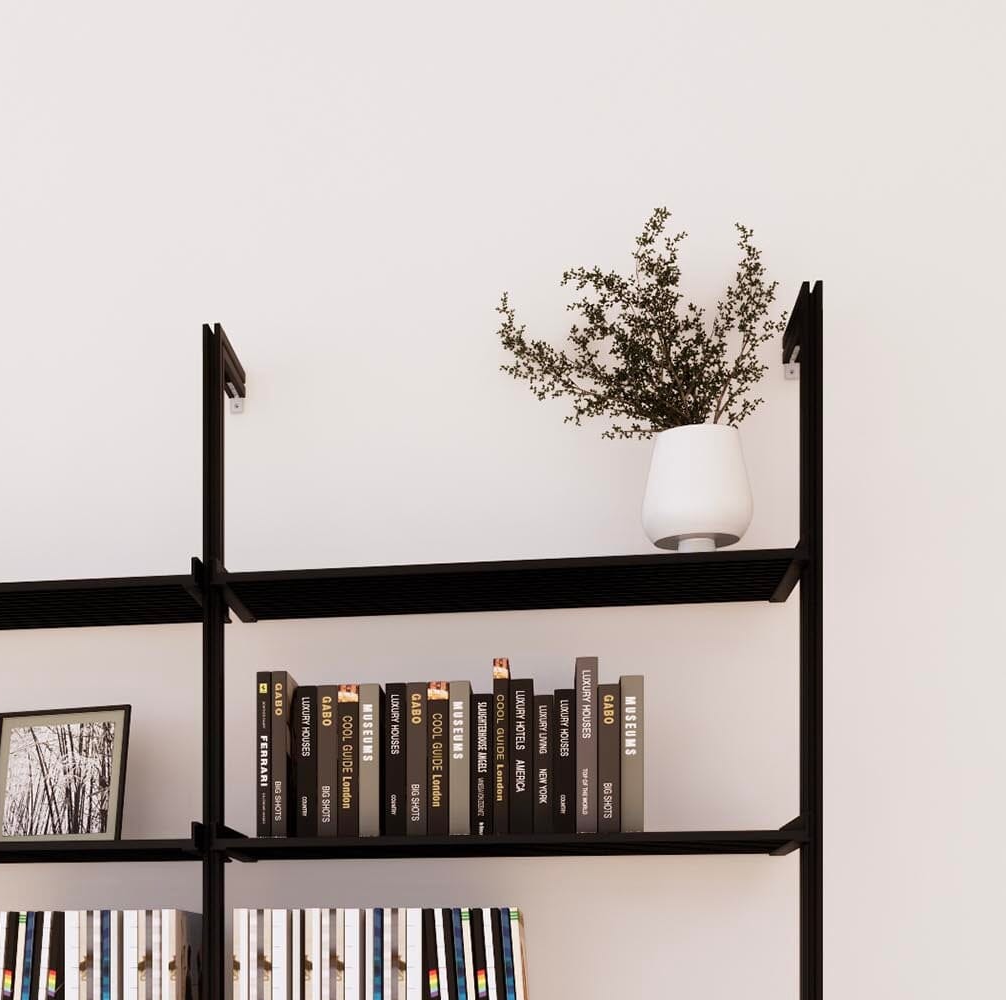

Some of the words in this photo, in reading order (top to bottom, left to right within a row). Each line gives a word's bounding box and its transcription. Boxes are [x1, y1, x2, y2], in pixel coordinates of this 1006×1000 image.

[275, 682, 283, 716] GABO
[582, 670, 591, 703] LUXURY
[301, 696, 310, 726] LUXURY
[322, 696, 332, 727] GABO
[390, 694, 399, 722] LUXURY
[411, 693, 422, 725] GABO
[496, 694, 505, 724] COOL
[515, 690, 525, 720] LUXURY
[539, 705, 547, 732] LUXURY
[560, 699, 569, 727] LUXURY
[603, 694, 614, 725] GABO
[342, 715, 353, 742] COOL
[362, 703, 373, 762] MUSEUMS
[432, 713, 443, 739] COOL
[452, 701, 464, 760] MUSEUMS
[477, 702, 487, 751] SLAUGHTERHOUSE
[515, 721, 525, 750] HOTELS
[582, 704, 591, 739] HOUSES
[625, 696, 636, 756] MUSEUMS
[302, 726, 311, 757] HOUSES
[391, 724, 399, 755] HOUSES
[496, 727, 505, 761] GUIDE
[539, 733, 547, 754] LIVING
[560, 728, 569, 757] HOUSES
[260, 735, 268, 787] FERRARI
[342, 744, 353, 773] GUIDE
[432, 742, 443, 771] GUIDE
[477, 752, 487, 773] ANGELS
[411, 783, 420, 796] BIG
[432, 774, 443, 808] London
[496, 763, 505, 802] London
[515, 759, 525, 793] AMERICA
[539, 768, 548, 784] NEW
[603, 782, 612, 795] BIG
[322, 785, 331, 798] BIG
[342, 776, 353, 809] London
[539, 785, 548, 804] YORK
[322, 799, 331, 823] SHOTS
[411, 797, 420, 822] SHOTS
[603, 795, 612, 819] SHOTS
